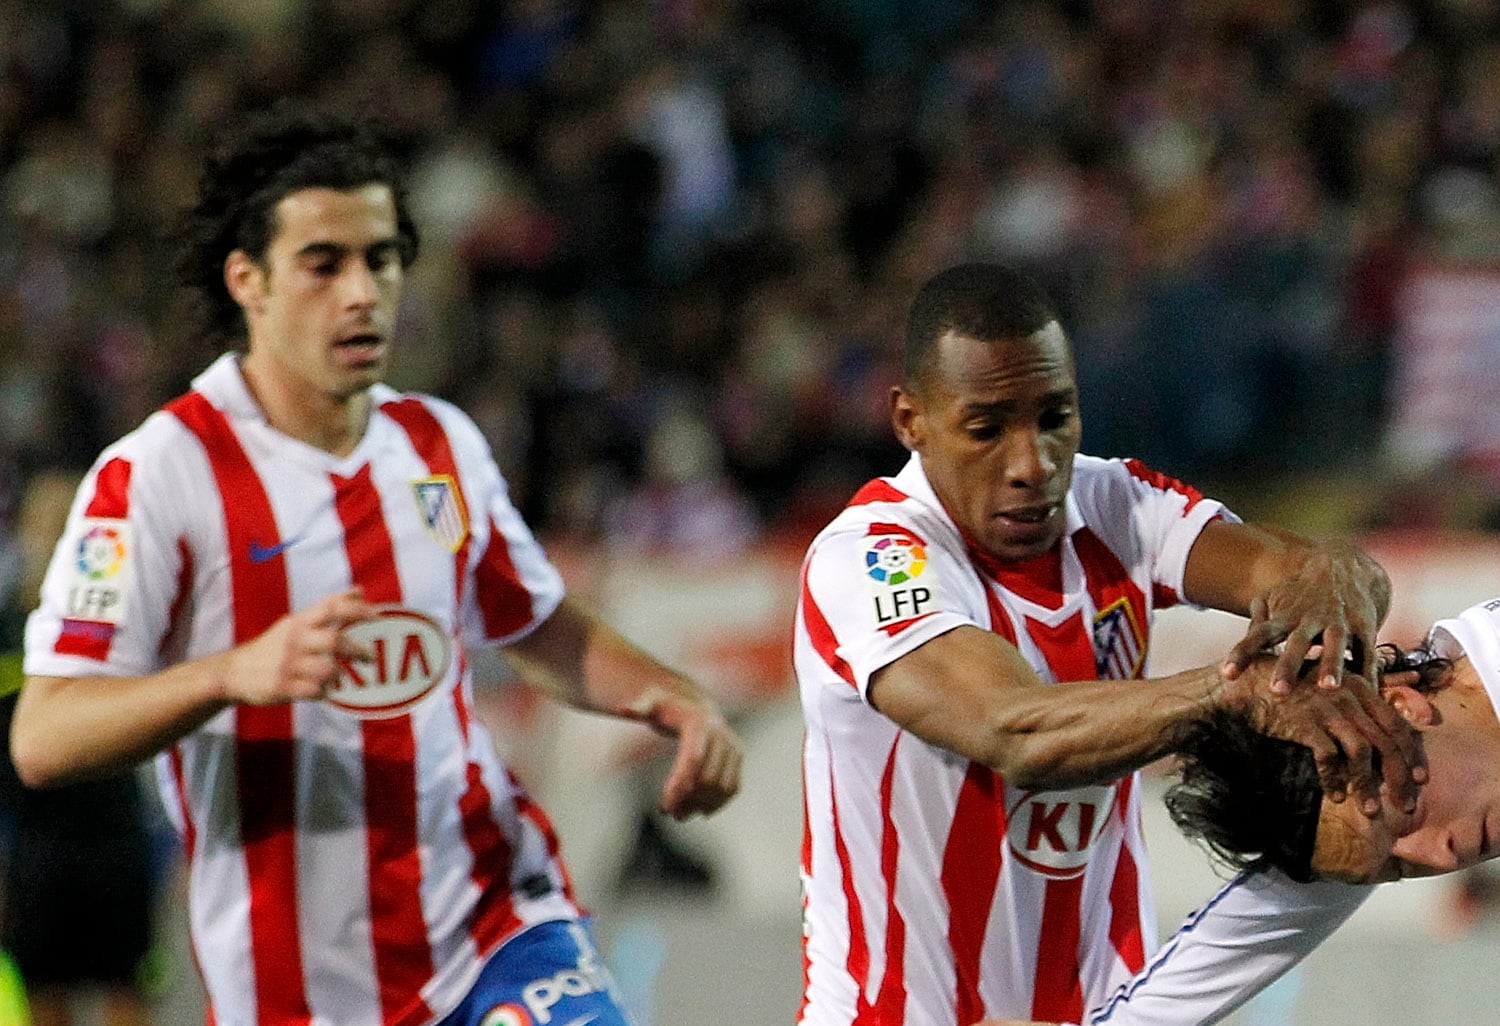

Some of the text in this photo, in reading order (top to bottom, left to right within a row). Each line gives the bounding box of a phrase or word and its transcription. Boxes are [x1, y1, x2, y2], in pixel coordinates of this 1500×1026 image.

[67, 587, 120, 615] LFP
[874, 587, 930, 622] LFP
[1026, 801, 1096, 853] KI
